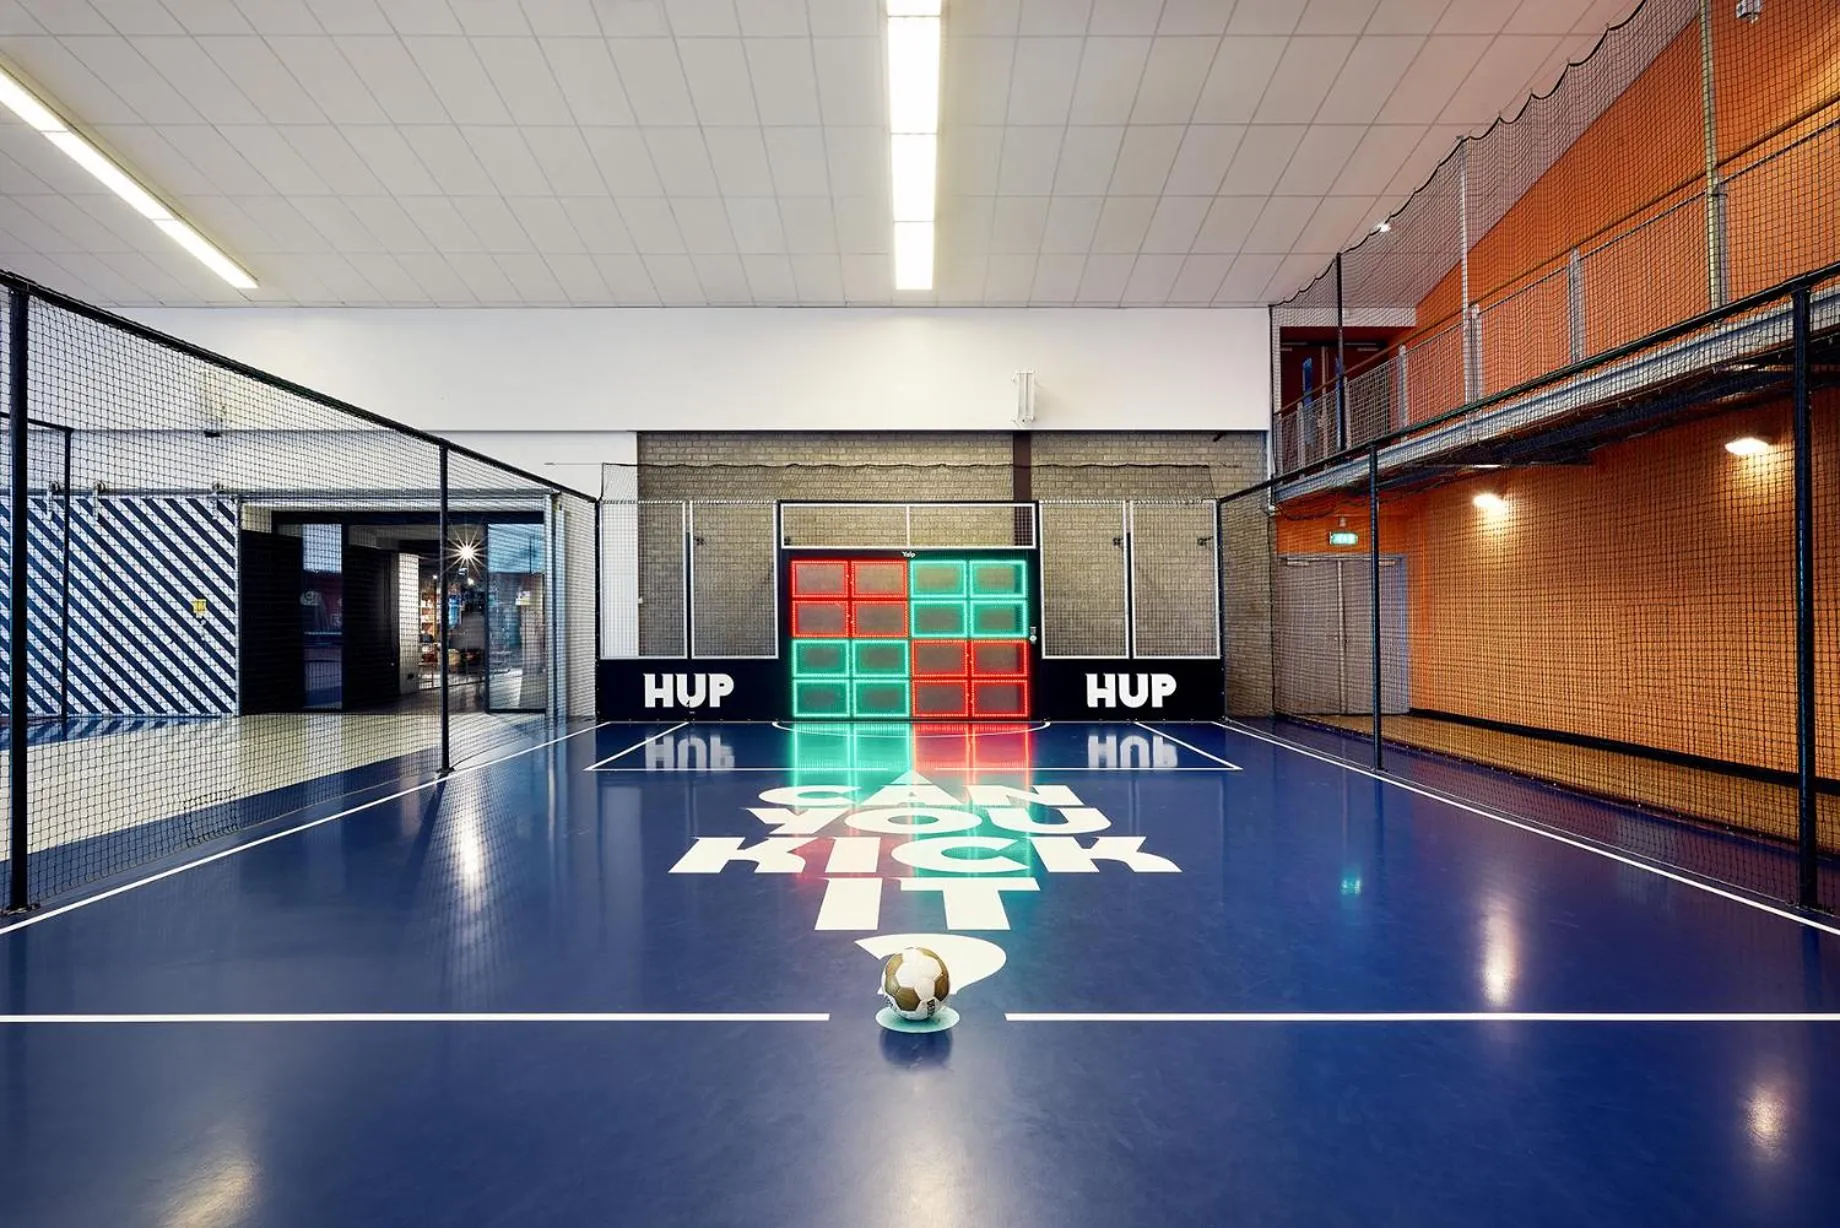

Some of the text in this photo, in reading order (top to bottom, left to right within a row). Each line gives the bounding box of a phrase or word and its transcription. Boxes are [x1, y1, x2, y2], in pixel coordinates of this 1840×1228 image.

[643, 673, 734, 708] HUP
[1085, 673, 1177, 708] HUP
[758, 769, 1085, 806] CAN
[742, 807, 1112, 835] YOU
[668, 836, 1183, 873] KICK
[814, 877, 1041, 931] IT
